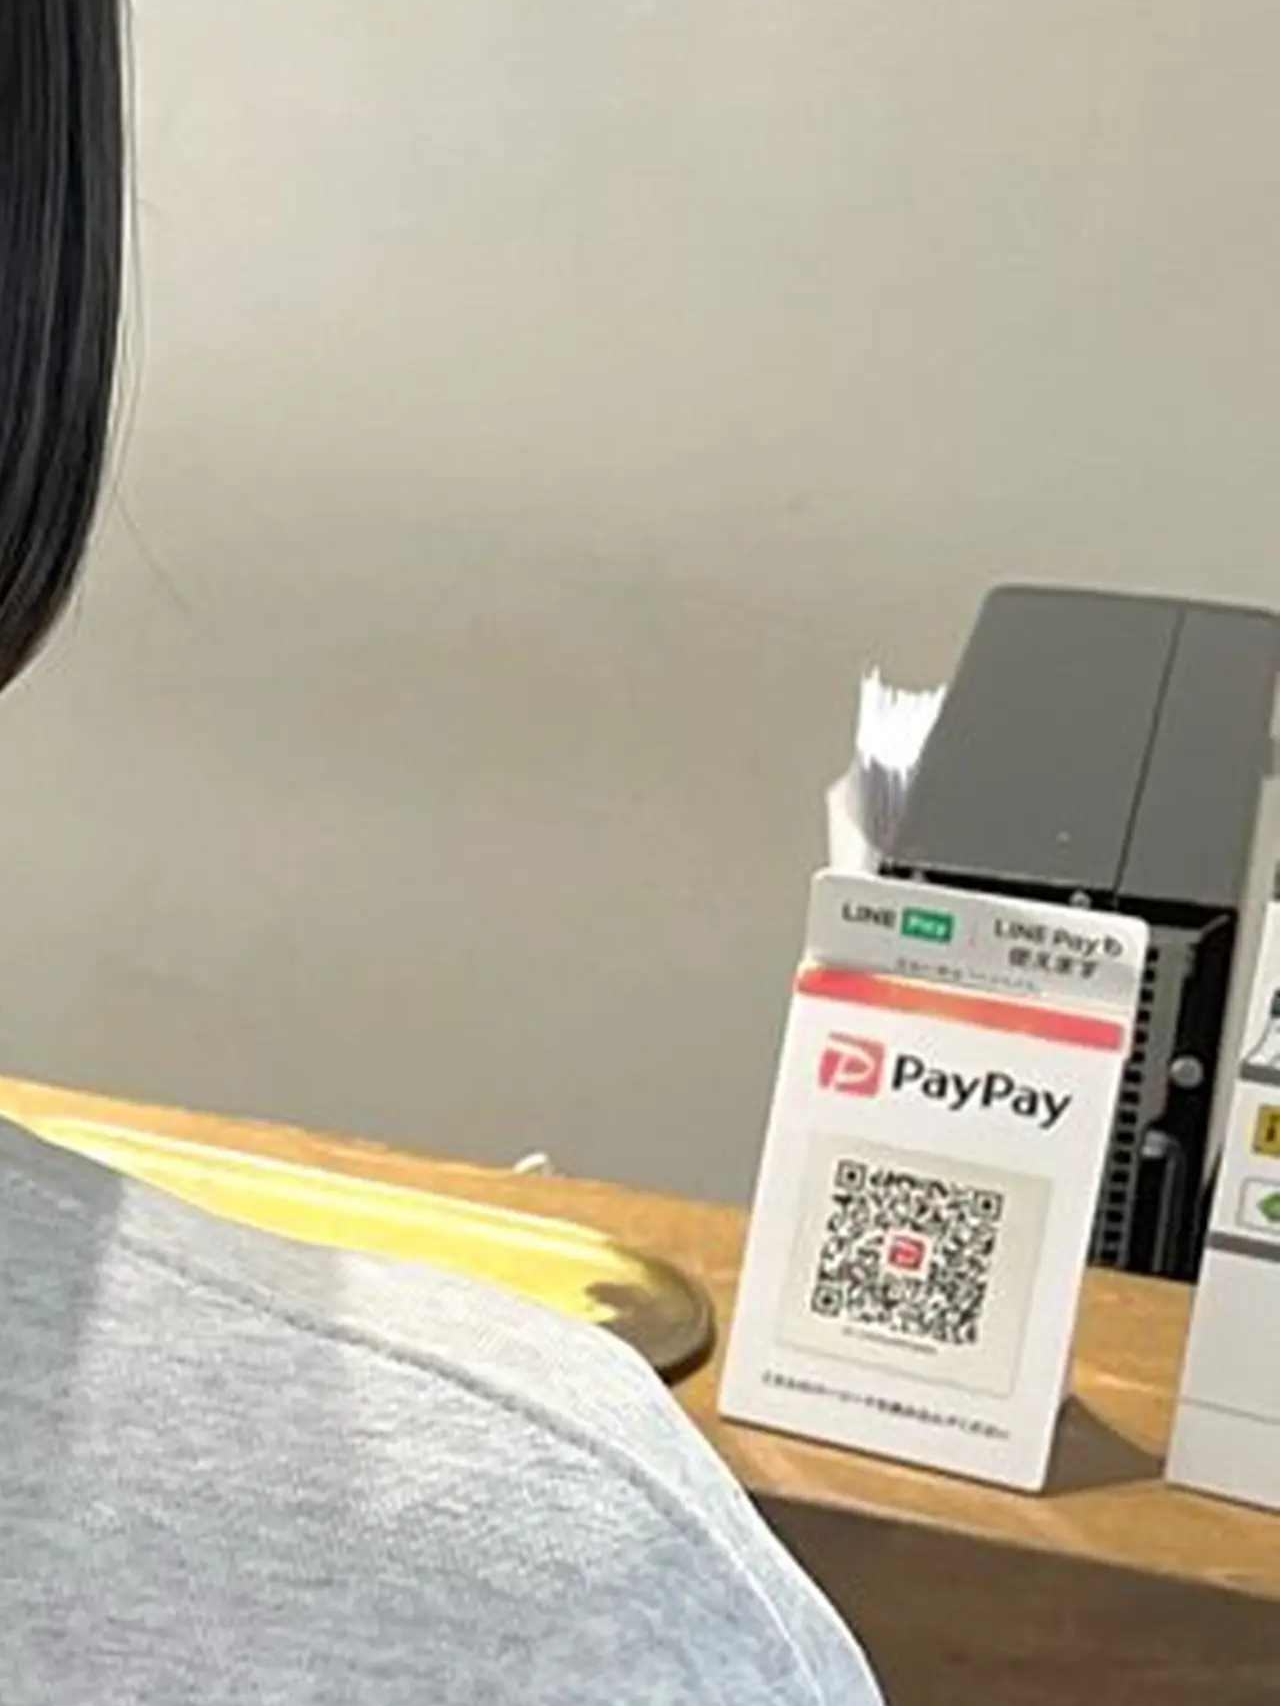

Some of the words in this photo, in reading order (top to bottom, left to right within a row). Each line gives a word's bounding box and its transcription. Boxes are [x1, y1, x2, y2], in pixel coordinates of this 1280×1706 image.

[842, 902, 896, 930] LINE
[905, 914, 948, 939] Pay
[994, 919, 1047, 945] LINE
[1007, 945, 1101, 979] 使えます
[891, 1053, 1073, 1130] PayPay
